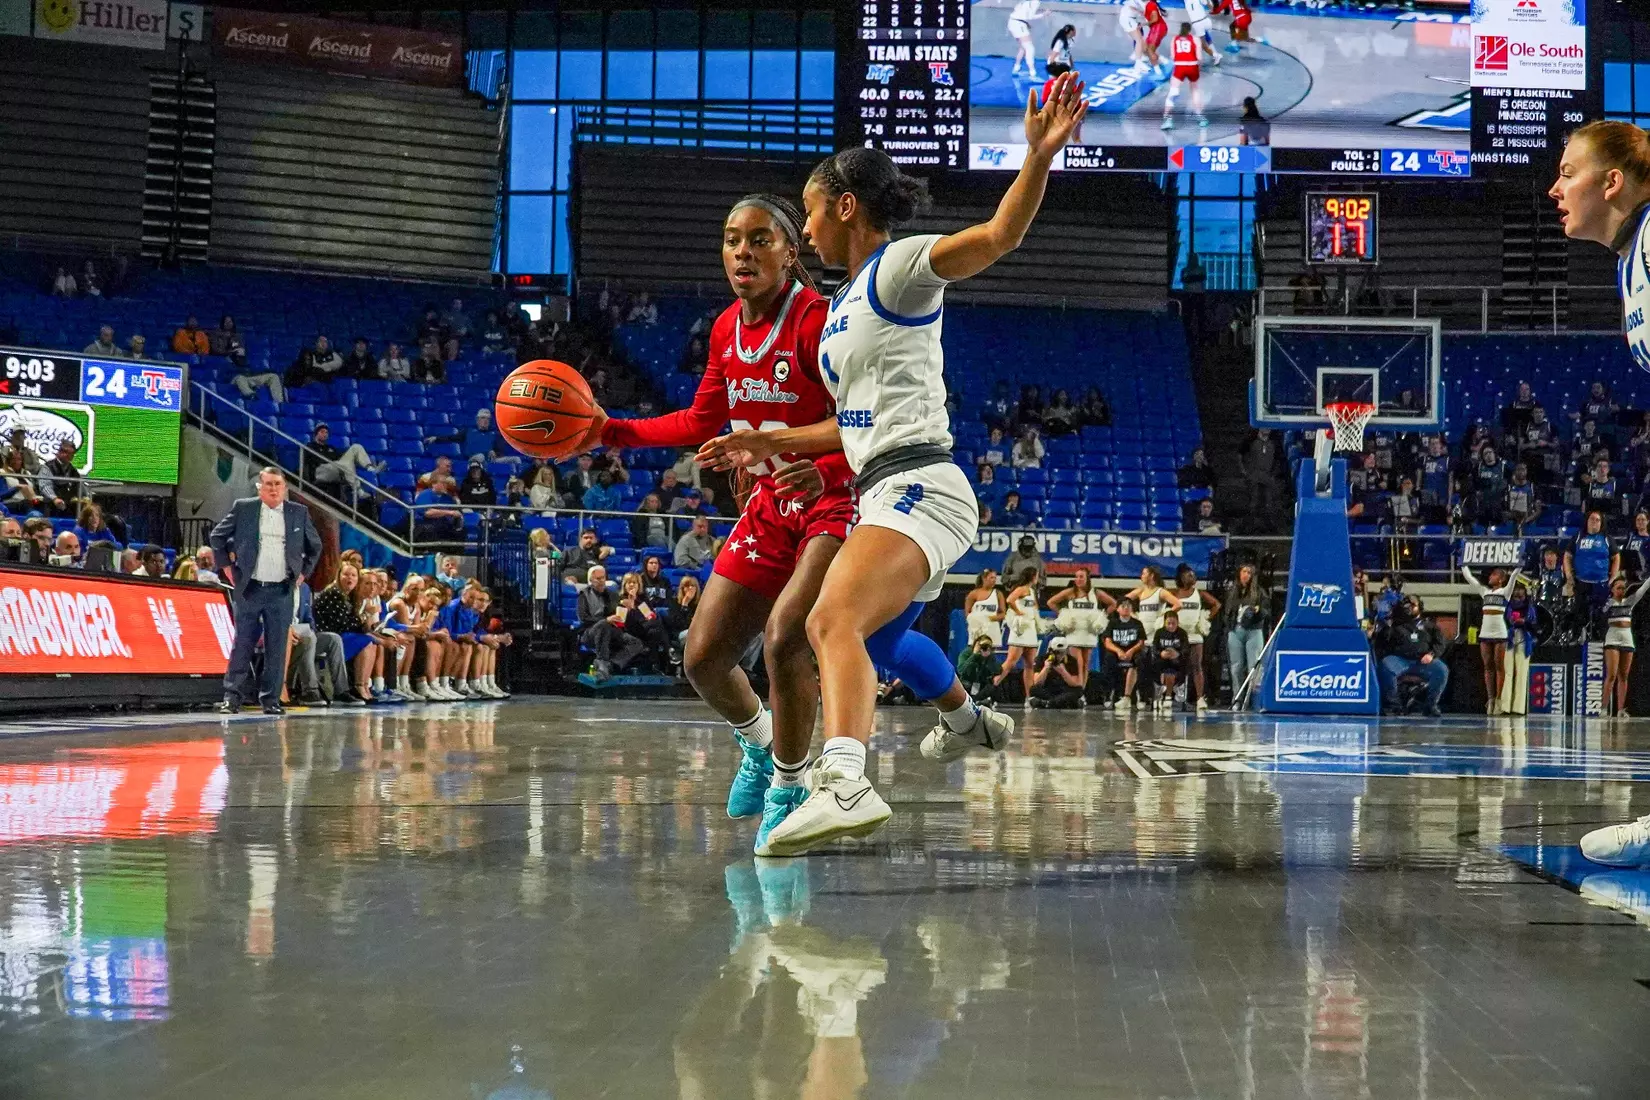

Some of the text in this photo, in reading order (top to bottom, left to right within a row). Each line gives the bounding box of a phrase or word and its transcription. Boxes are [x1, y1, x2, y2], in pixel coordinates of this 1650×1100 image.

[863, 4, 964, 14] 18 2 2 1 1
[78, 1, 165, 33] Hiller
[863, 17, 964, 27] 22 5 4 1 0
[226, 27, 289, 48] Ascend
[863, 30, 964, 39] 23 12 1 0 2
[309, 36, 373, 58] Ascend
[868, 46, 957, 61] TEAM STATS
[1510, 43, 1583, 58] Ole South
[391, 46, 452, 68] Ascend
[860, 89, 964, 101] 40.0 FG% 22.7
[1483, 88, 1573, 98] MEN'S BASKETBALL
[1500, 99, 1546, 110] 15 OREGON
[861, 107, 962, 118] 25.0 3PT% 44.4
[1498, 111, 1546, 121] MINNESOTA
[1563, 112, 1583, 122] 3:00
[864, 125, 964, 135] 7-8 FT M-A 10-12
[1498, 125, 1546, 135] MISSISSIPPI
[865, 140, 960, 150] 6 TURNOVERS 11
[1492, 139, 1546, 148] 22 MISSOURI
[1066, 147, 1087, 157] TOL
[1095, 147, 1102, 157] 4
[1200, 147, 1239, 163] 9:03
[1344, 151, 1364, 160] TOL
[1372, 151, 1379, 161] 3
[1470, 152, 1529, 164] ANASTASIA
[891, 156, 917, 164] RGEST
[949, 155, 957, 166] 2
[1066, 158, 1099, 167] FOULS
[1107, 158, 1114, 168] 0
[1211, 163, 1229, 171] 3RD
[1331, 161, 1364, 171] FOULS
[1372, 161, 1379, 171] 0
[1390, 152, 1421, 171] 24
[1326, 198, 1371, 220] 9:02
[1332, 220, 1365, 255] 17
[5, 357, 56, 382] 9:03
[86, 366, 128, 399] 24
[18, 383, 42, 397] 3rd
[509, 379, 564, 405] ELITE
[742, 377, 799, 404] Techsters
[1071, 535, 1184, 558] SECTION
[1463, 541, 1521, 564] DEFENSE
[1298, 583, 1342, 613] MT
[0, 586, 128, 658] ATABURGER
[1281, 669, 1362, 689] Ascend
[1585, 642, 1604, 715] MAKE NOISE
[1279, 688, 1308, 696] Federal
[1310, 689, 1333, 697] Credit
[1551, 666, 1563, 714] FROSTY!
